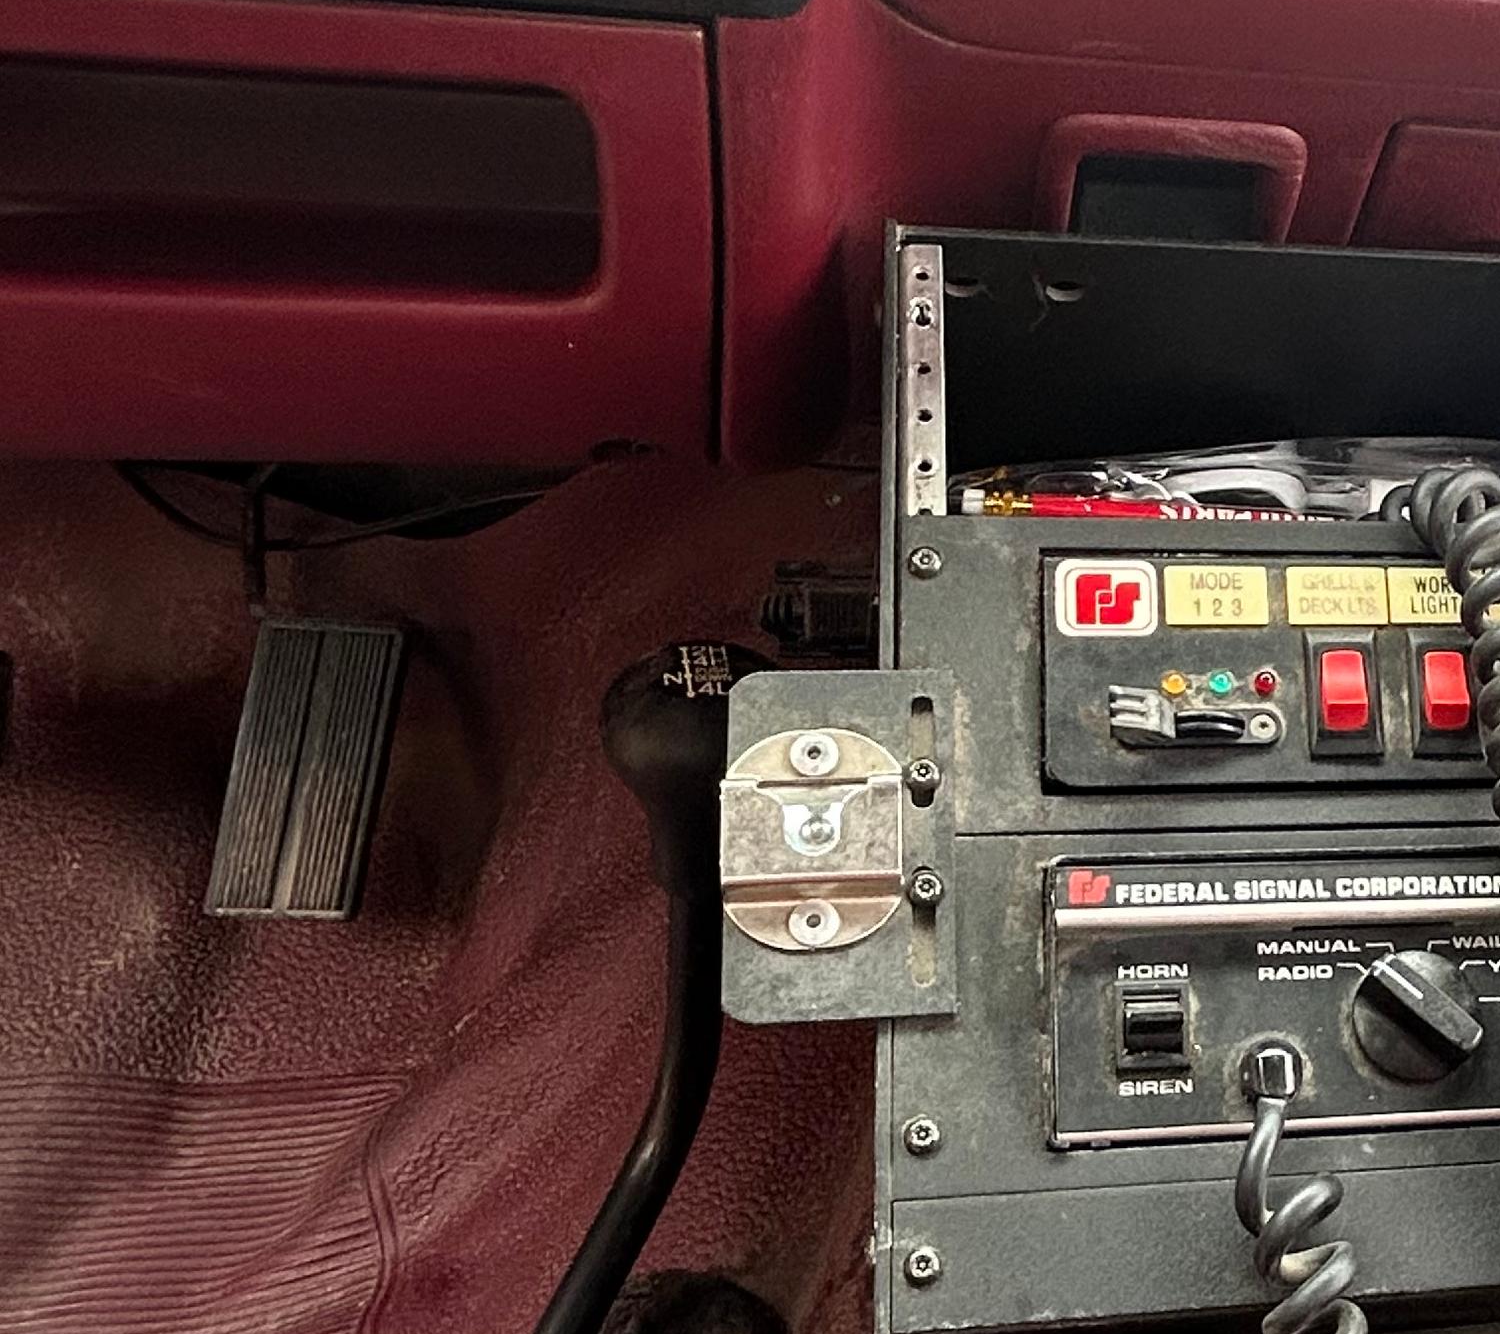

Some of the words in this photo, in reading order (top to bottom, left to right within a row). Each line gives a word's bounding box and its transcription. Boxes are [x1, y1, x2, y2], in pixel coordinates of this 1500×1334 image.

[1189, 572, 1244, 591] MODE
[1414, 575, 1453, 594] WOR
[1193, 598, 1202, 616] 1
[1211, 598, 1223, 617] 2
[1231, 598, 1244, 616] 3
[1298, 596, 1345, 616] DECK
[1410, 595, 1461, 615] LIGHT
[663, 671, 682, 686] N
[697, 681, 730, 696] 4L
[1115, 880, 1230, 906] FEDERAL
[1233, 877, 1332, 902] SIGNAL
[1256, 940, 1362, 956] MANUAL
[1116, 963, 1189, 980] HORN
[1257, 962, 1334, 982] RADIO
[1117, 1078, 1195, 1098] SIREN
